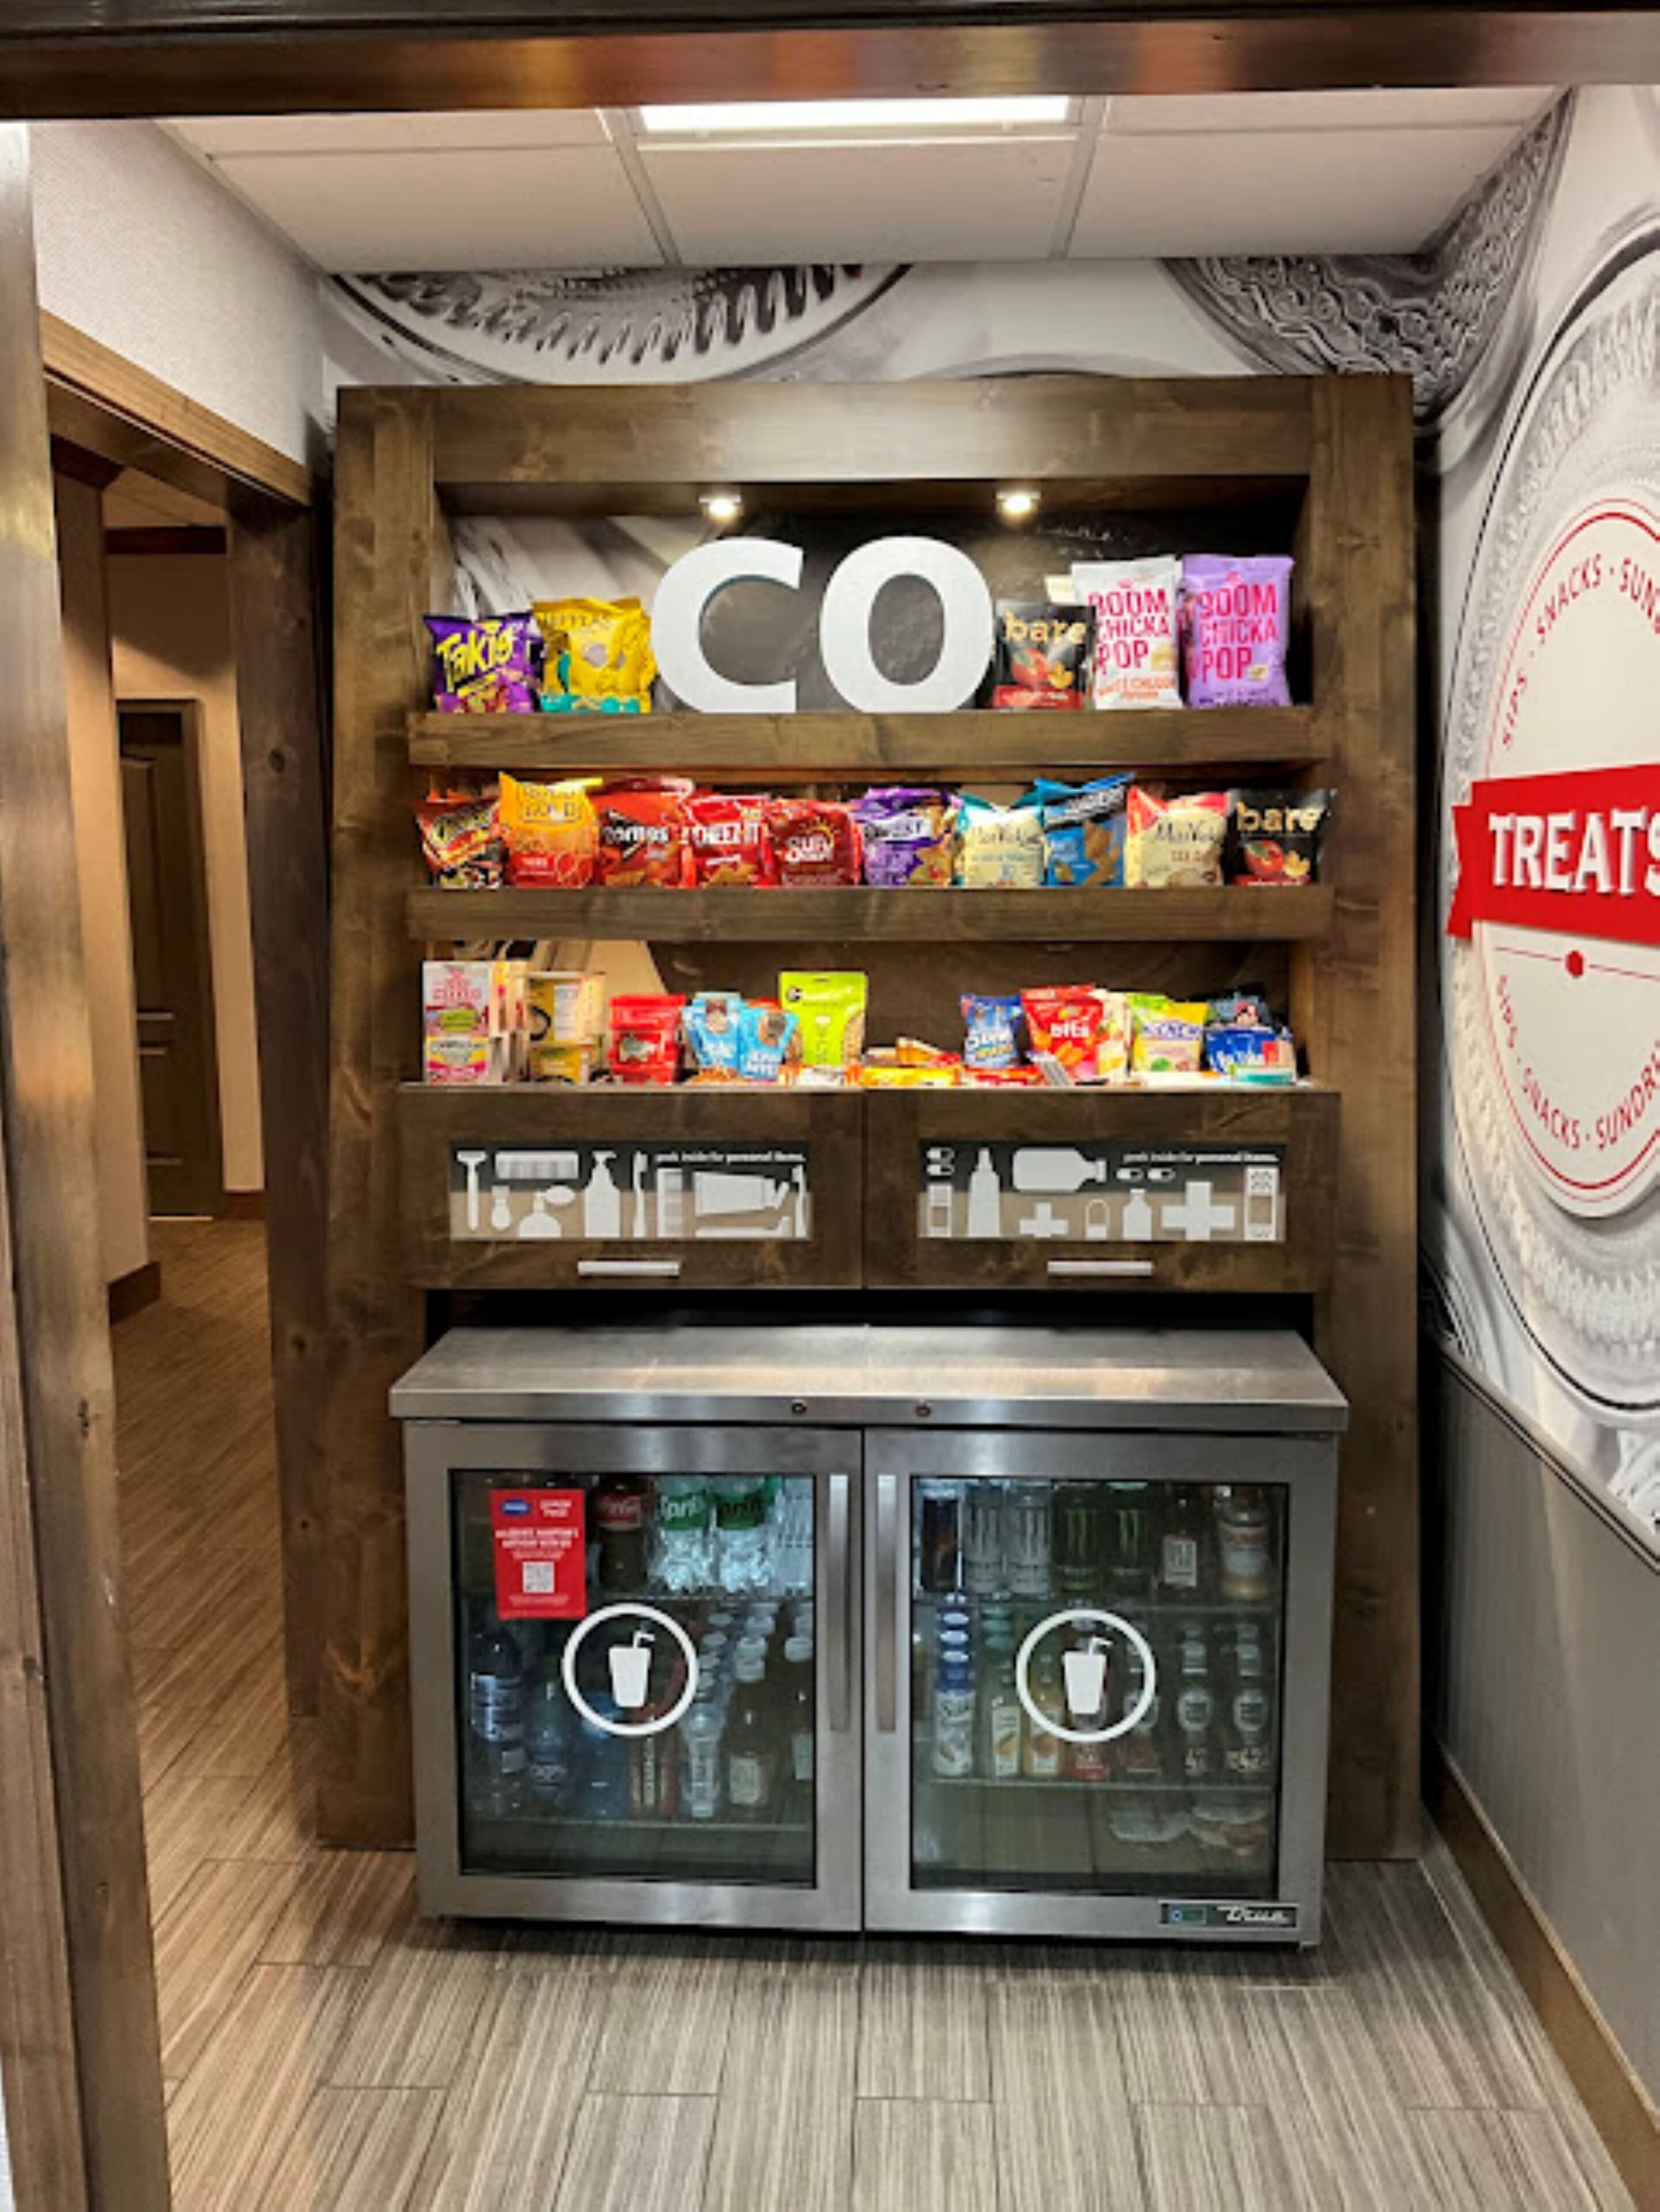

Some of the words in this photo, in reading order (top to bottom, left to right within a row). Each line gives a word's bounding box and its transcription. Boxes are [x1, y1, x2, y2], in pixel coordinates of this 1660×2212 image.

[1199, 584, 1277, 619] BOOM
[1537, 553, 1601, 645] SNACKS
[652, 536, 993, 713] CO
[1005, 609, 1087, 644] bare
[1201, 618, 1278, 647] CHICKA
[436, 621, 513, 693] Takis
[1096, 639, 1149, 675] POP
[1201, 646, 1252, 684] POP
[1237, 801, 1323, 831] bare
[1522, 1067, 1580, 1149] SNACKS
